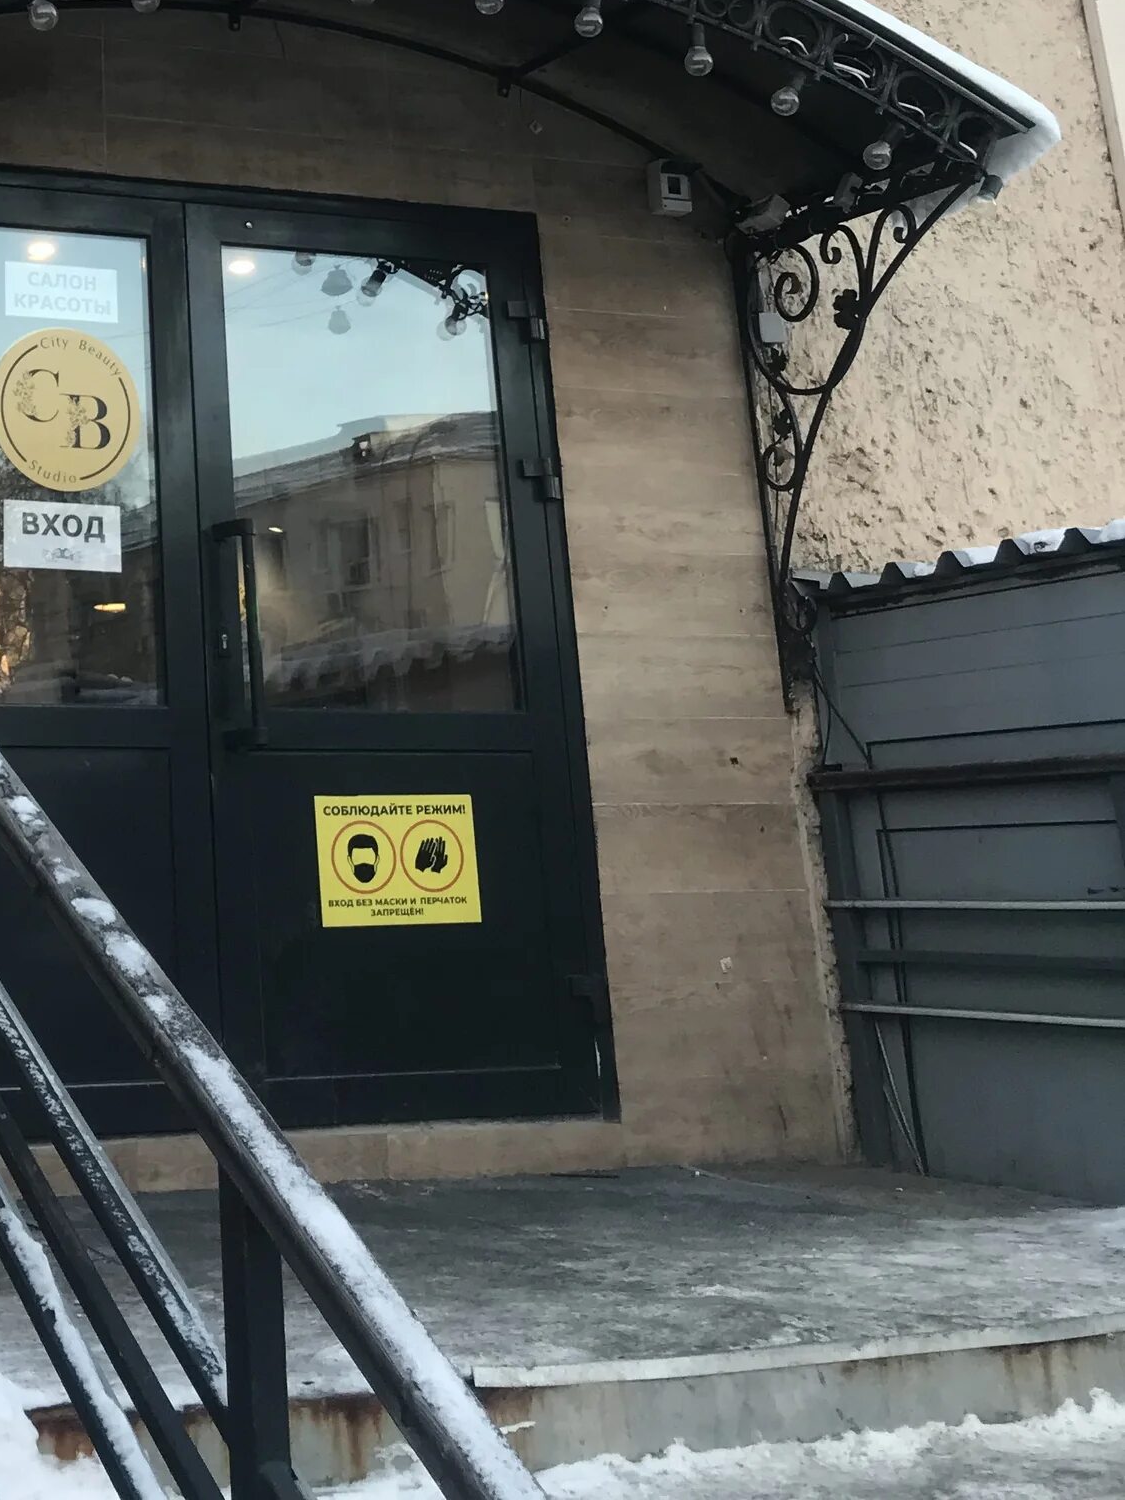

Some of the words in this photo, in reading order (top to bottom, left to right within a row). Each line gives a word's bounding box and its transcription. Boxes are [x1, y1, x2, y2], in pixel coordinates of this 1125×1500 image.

[27, 271, 97, 292] САЛОН
[13, 293, 111, 316] КРАСОТЫ
[40, 337, 69, 349] City
[78, 339, 122, 377] Beauty
[29, 460, 77, 484] Studio
[22, 512, 106, 543] ВХОД
[323, 803, 413, 817] СОБЛЮДАЙТЕ
[416, 804, 466, 815] РЕЖИМ!
[328, 900, 354, 908] ВХОД
[356, 899, 373, 907] БЕЗ
[375, 898, 407, 907] МАСКИ
[420, 896, 467, 905] ПЕРЧАТОК
